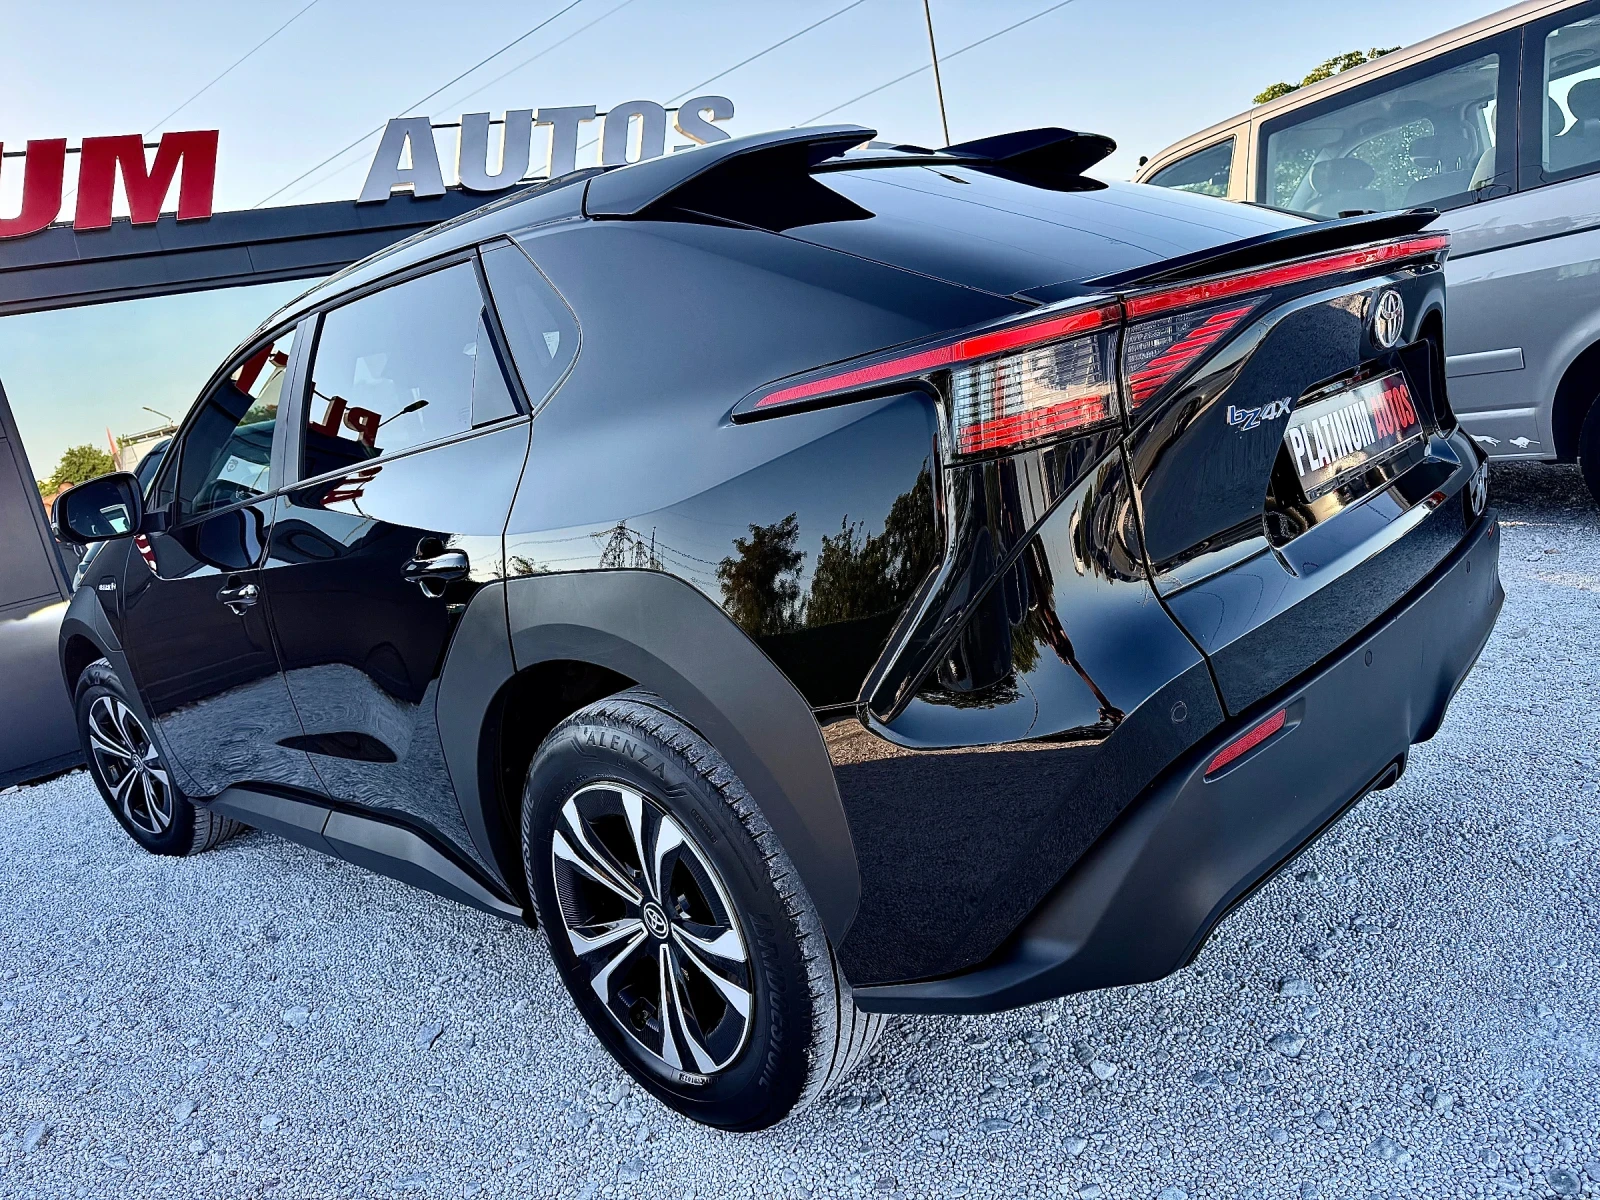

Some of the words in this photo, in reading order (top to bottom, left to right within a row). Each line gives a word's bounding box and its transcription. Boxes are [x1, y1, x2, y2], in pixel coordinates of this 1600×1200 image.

[356, 96, 734, 204] AUTOS
[1288, 400, 1376, 477] PLATINUM
[1370, 384, 1415, 440] AUTOS
[584, 728, 667, 781] ALENZA
